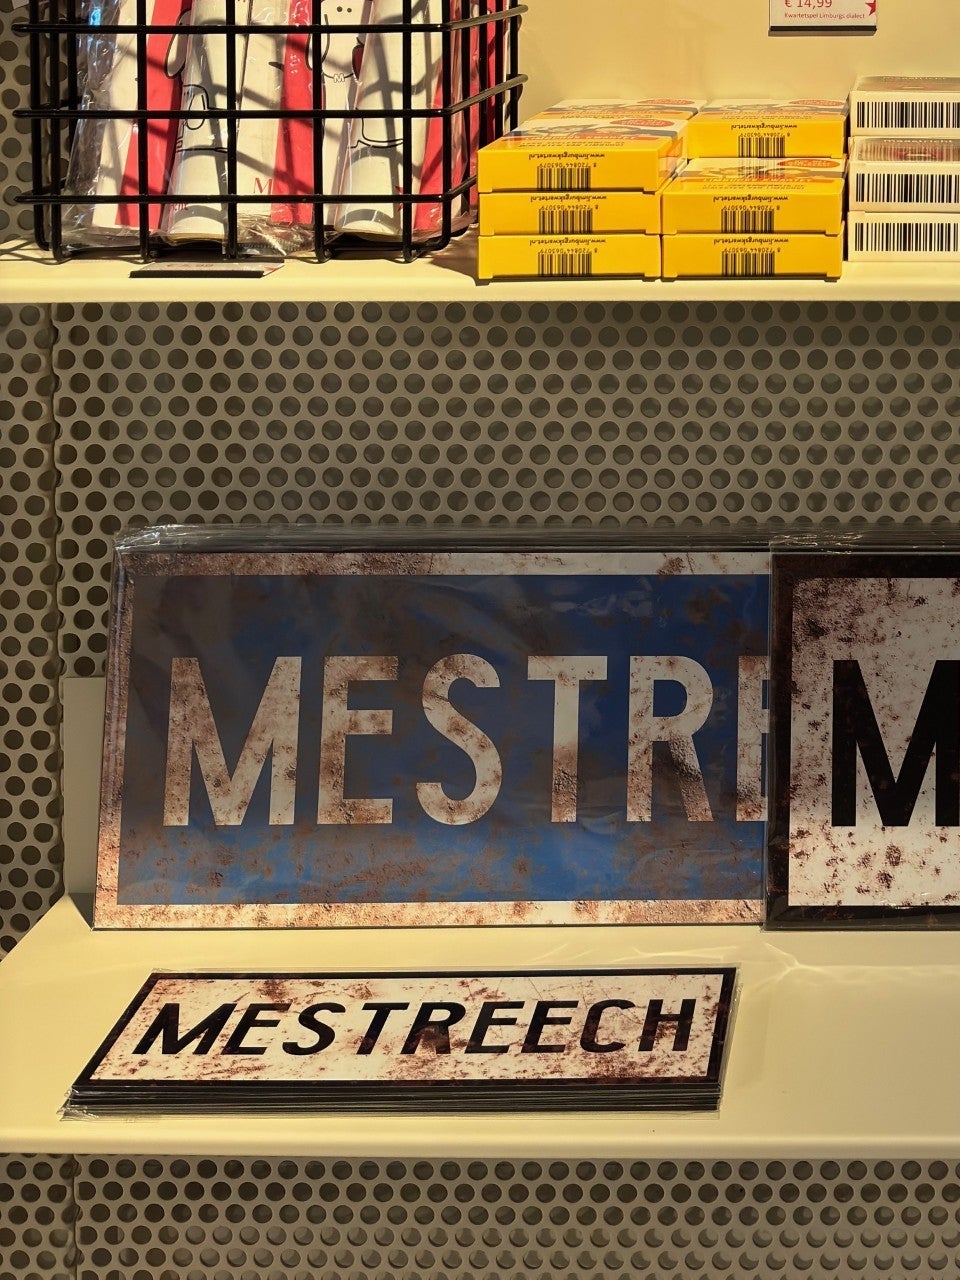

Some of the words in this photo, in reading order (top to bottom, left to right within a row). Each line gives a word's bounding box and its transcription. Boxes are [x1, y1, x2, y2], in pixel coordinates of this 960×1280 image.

[730, 122, 798, 132] www.limburgskwartet.nl
[528, 152, 606, 162] www.limburgskwartet.nl
[530, 194, 608, 204] www.limburgskwartet.nl
[712, 194, 790, 204] www.limburgskwartet.nl
[528, 237, 607, 247] www.limburgskwartet.nl
[712, 237, 790, 247] www.limburgskwartet.nl
[132, 997, 698, 1057] MESTREECH
